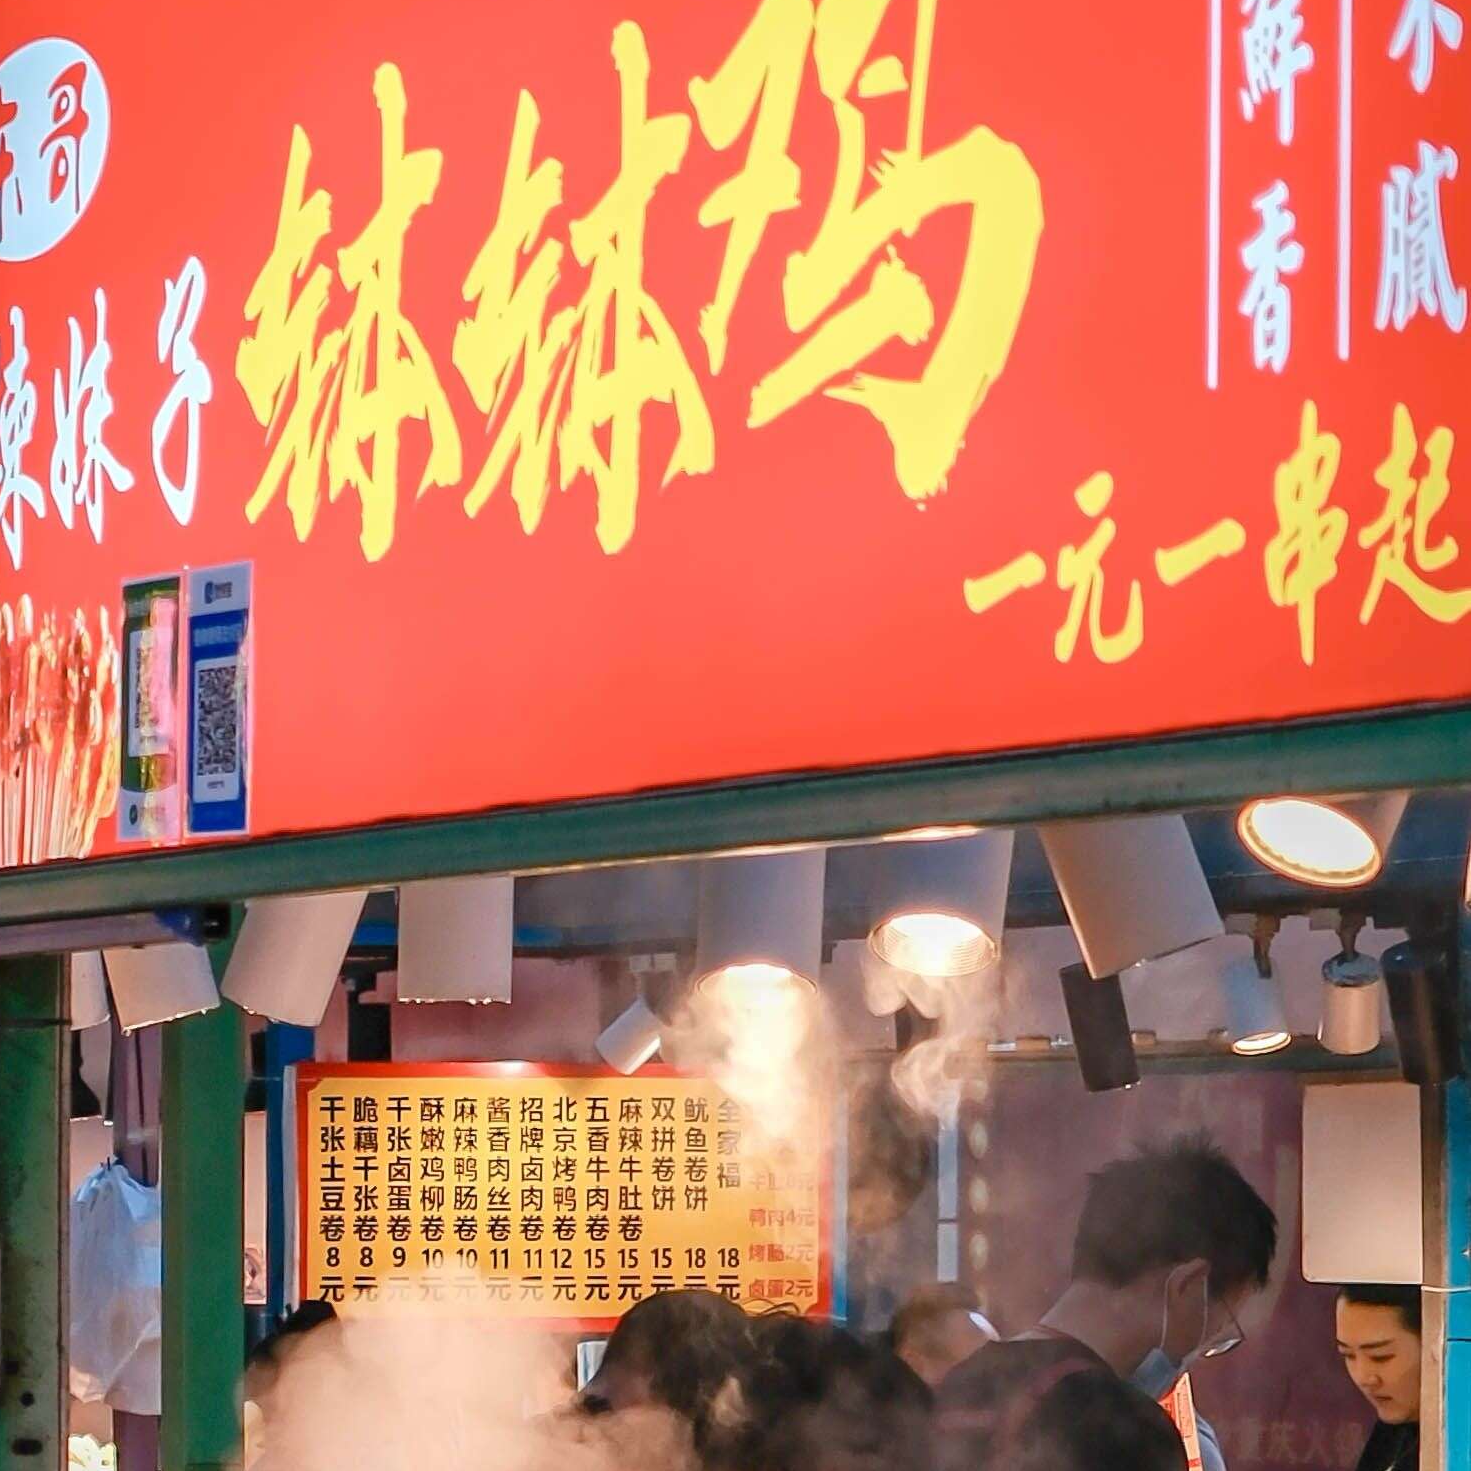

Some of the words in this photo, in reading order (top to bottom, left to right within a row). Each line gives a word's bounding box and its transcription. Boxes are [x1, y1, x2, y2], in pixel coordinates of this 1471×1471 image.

[964, 399, 1471, 667] 一元一串起
